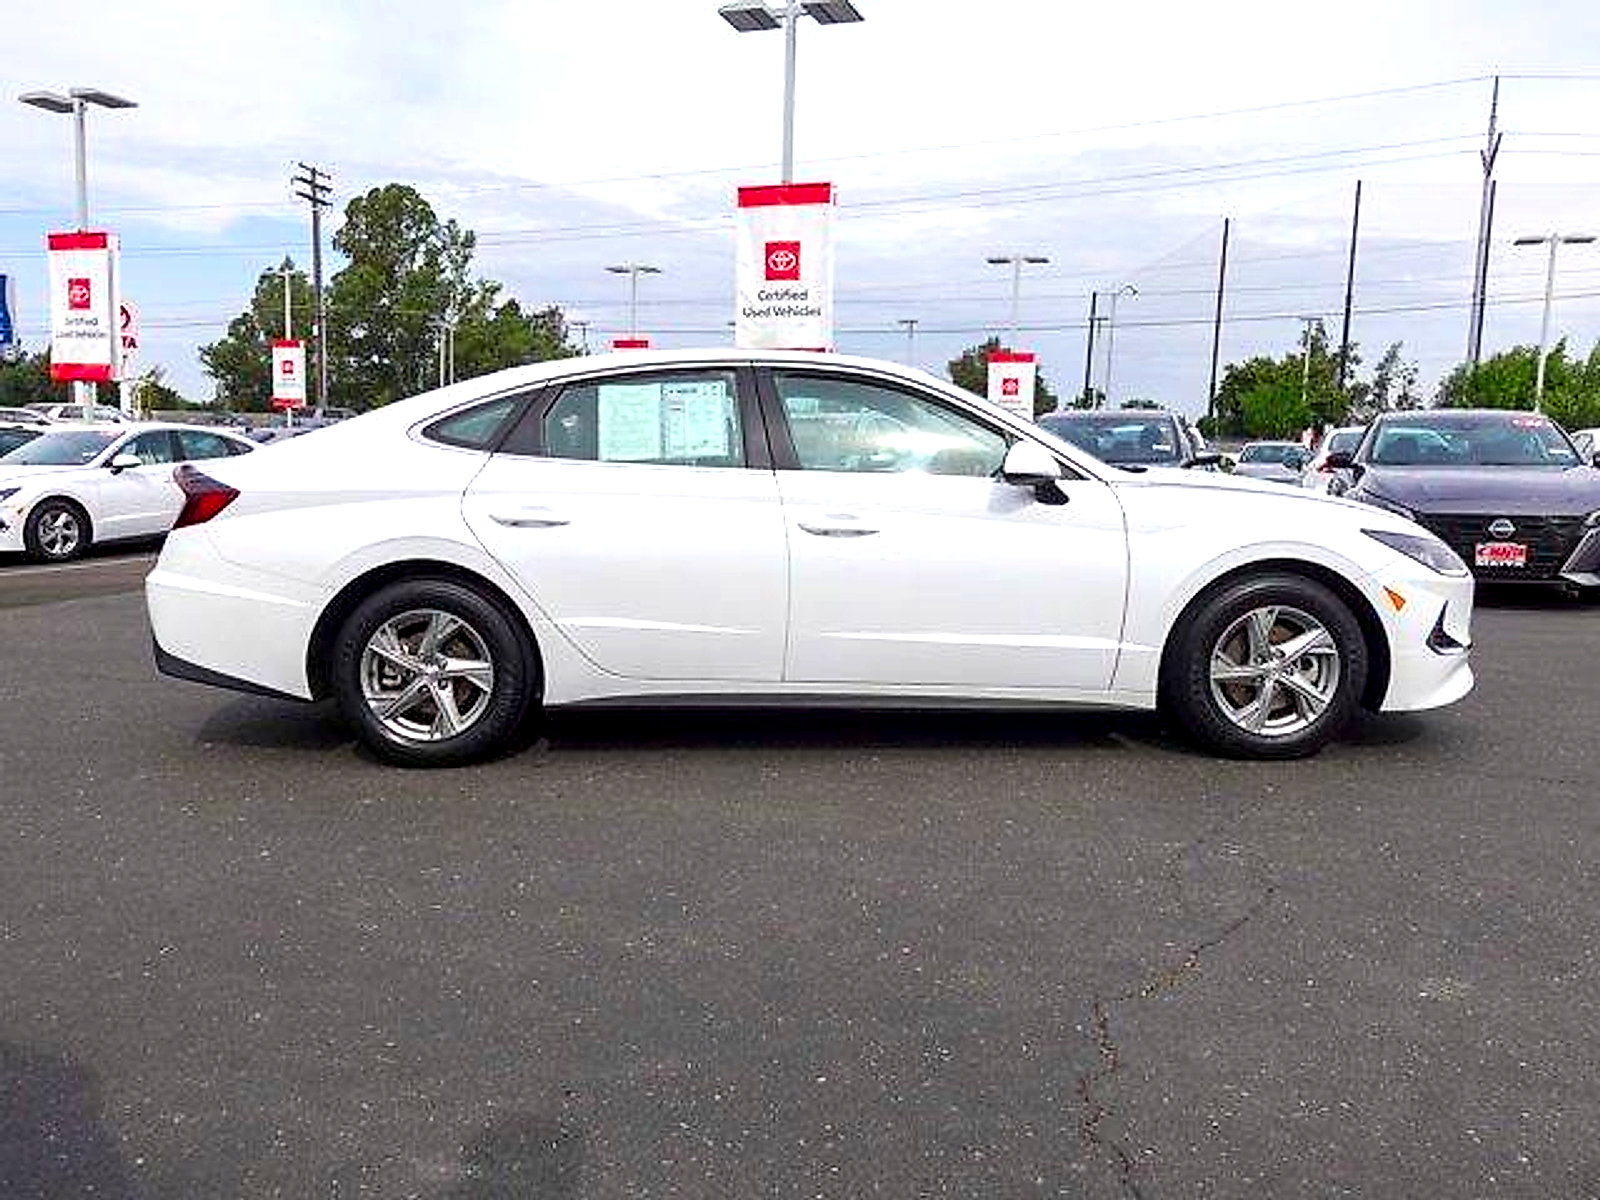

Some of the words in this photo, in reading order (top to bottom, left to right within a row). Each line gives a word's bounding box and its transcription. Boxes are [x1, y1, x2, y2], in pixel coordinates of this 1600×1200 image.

[757, 289, 809, 302] Certified
[742, 306, 771, 319] Used
[772, 305, 821, 318] Vehicles
